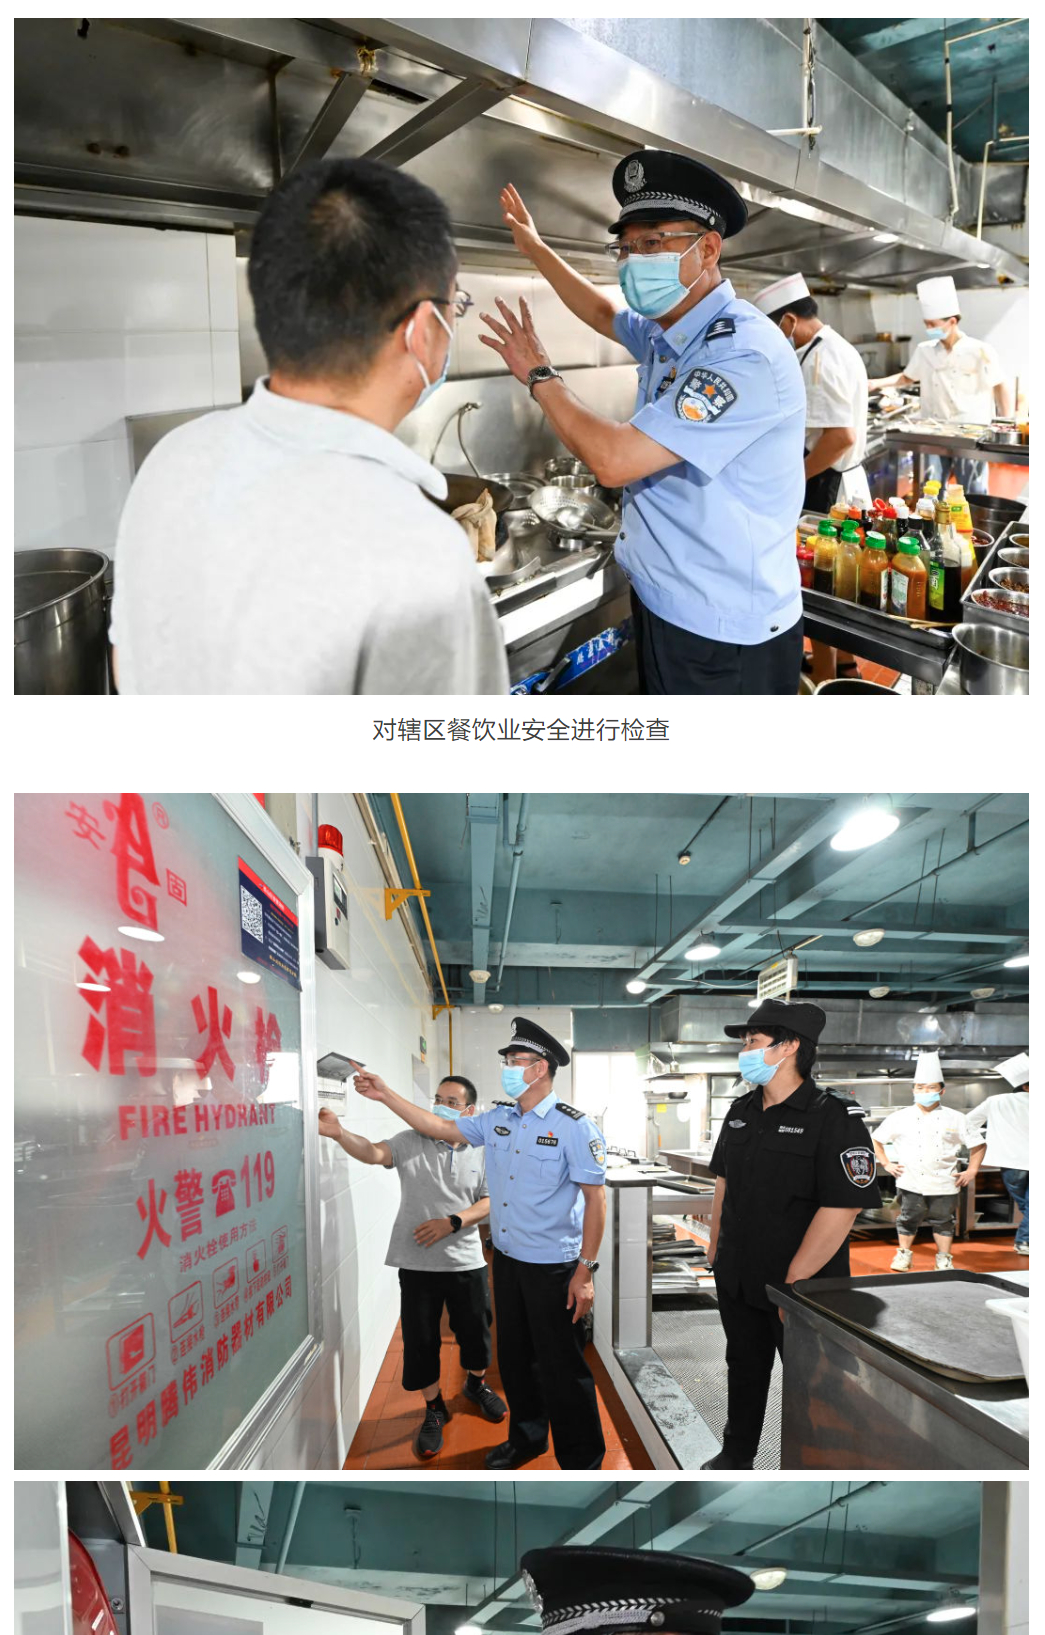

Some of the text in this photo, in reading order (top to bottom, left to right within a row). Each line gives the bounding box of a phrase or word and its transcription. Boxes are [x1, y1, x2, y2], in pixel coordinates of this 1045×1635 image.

[119, 1103, 276, 1141] FIRE HYDRANT
[136, 1150, 276, 1260] 火警 119
